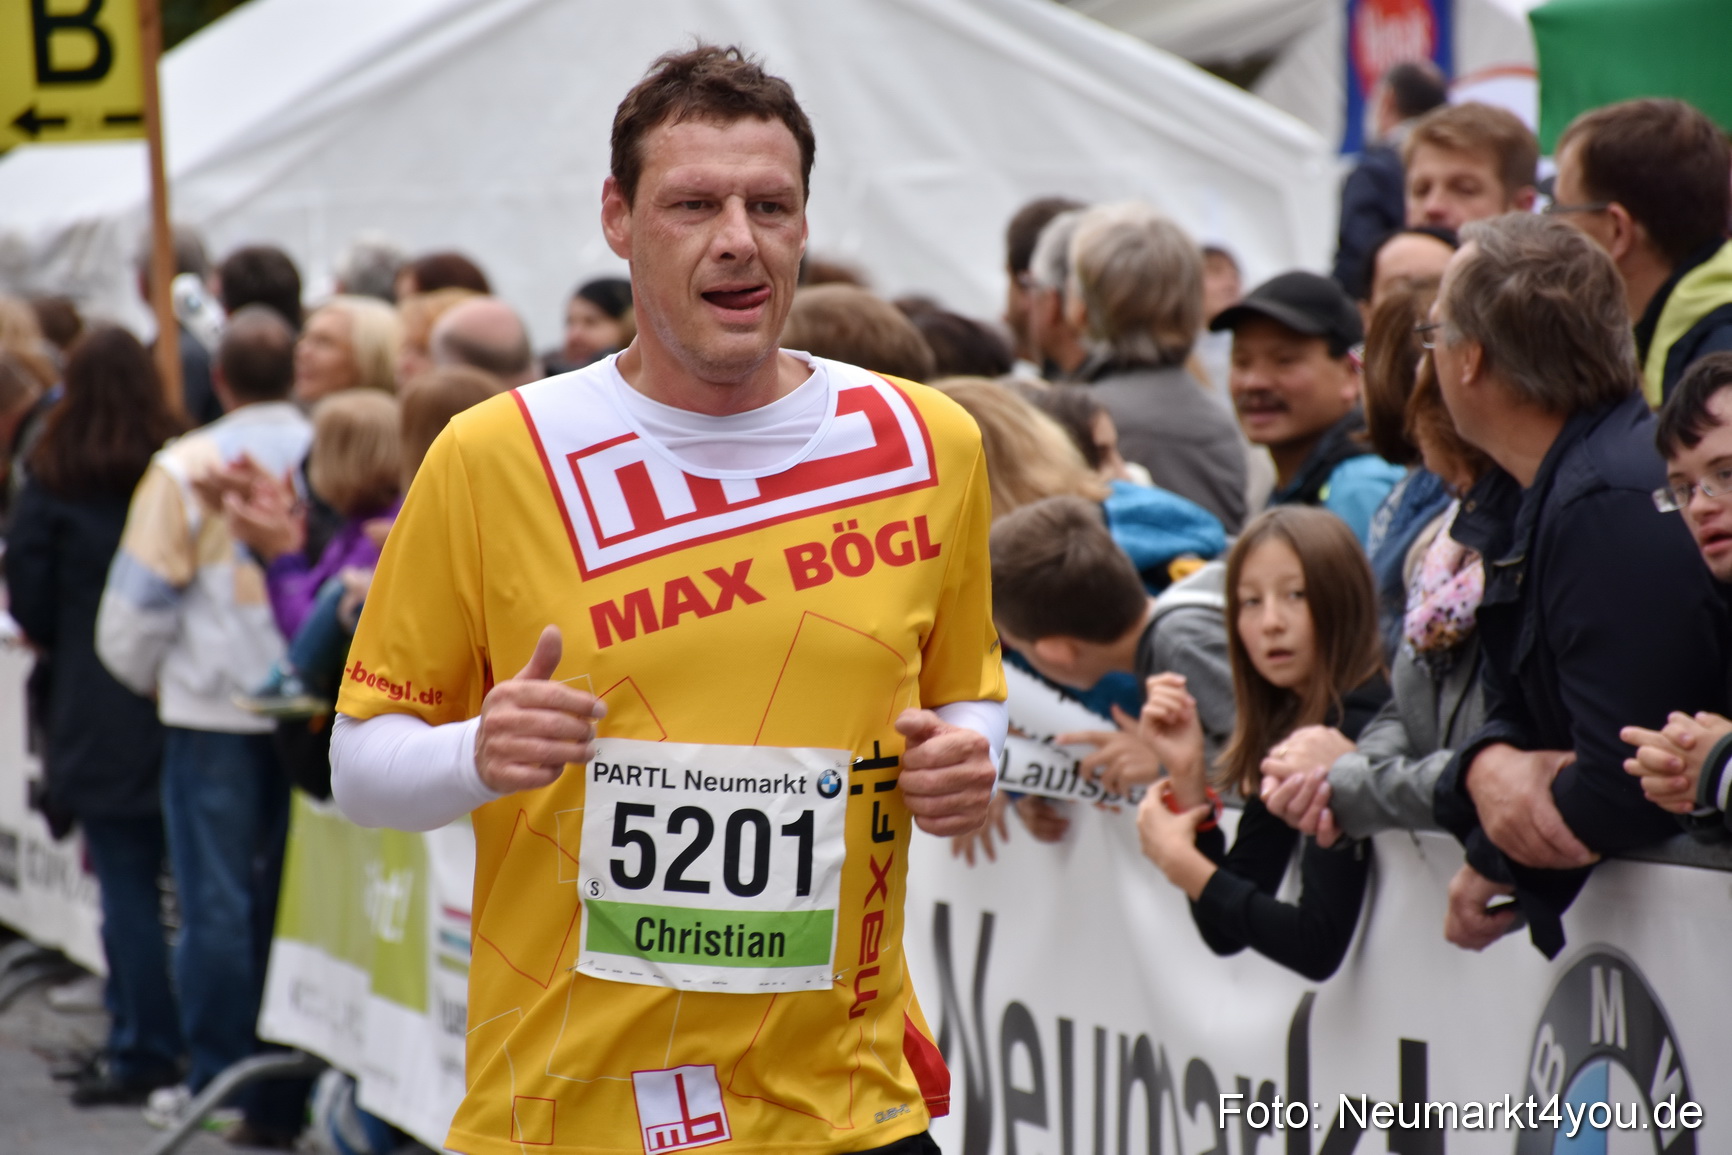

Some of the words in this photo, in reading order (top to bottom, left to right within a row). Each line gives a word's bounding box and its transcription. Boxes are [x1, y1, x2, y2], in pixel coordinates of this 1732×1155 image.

[30, 0, 115, 84] B
[589, 558, 767, 650] MAX
[784, 515, 942, 592] BÖGL
[594, 762, 676, 789] PARTL
[684, 769, 807, 795] Neumarkt
[609, 801, 815, 898] 5201
[635, 916, 786, 958] Christian
